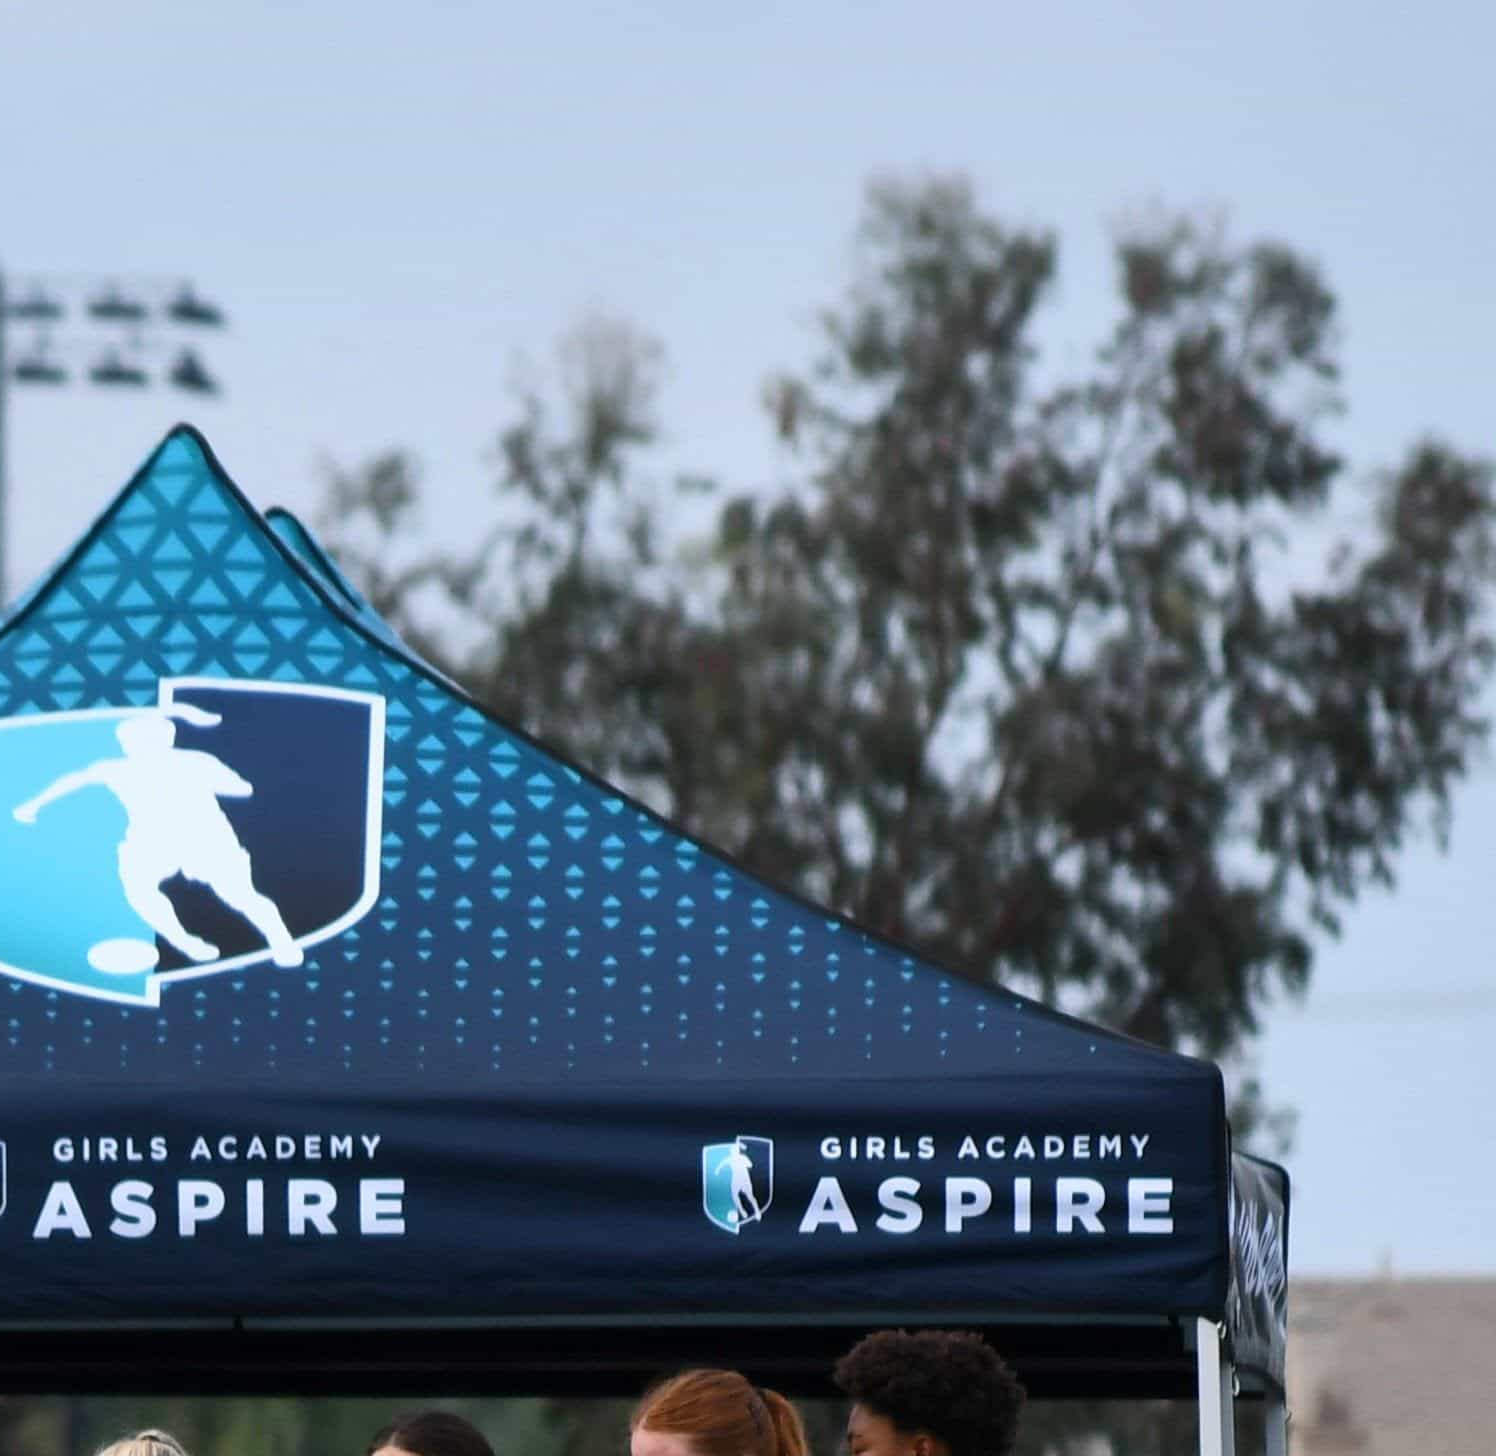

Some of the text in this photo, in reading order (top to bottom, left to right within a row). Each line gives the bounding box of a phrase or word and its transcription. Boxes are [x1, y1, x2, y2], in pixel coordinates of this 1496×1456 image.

[53, 1134, 381, 1162] GIRLS ACADEMY
[820, 1134, 1149, 1160] GIRLS ACADEMY
[33, 1178, 406, 1239] ASPIRE
[799, 1176, 1174, 1234] ASPIRE
